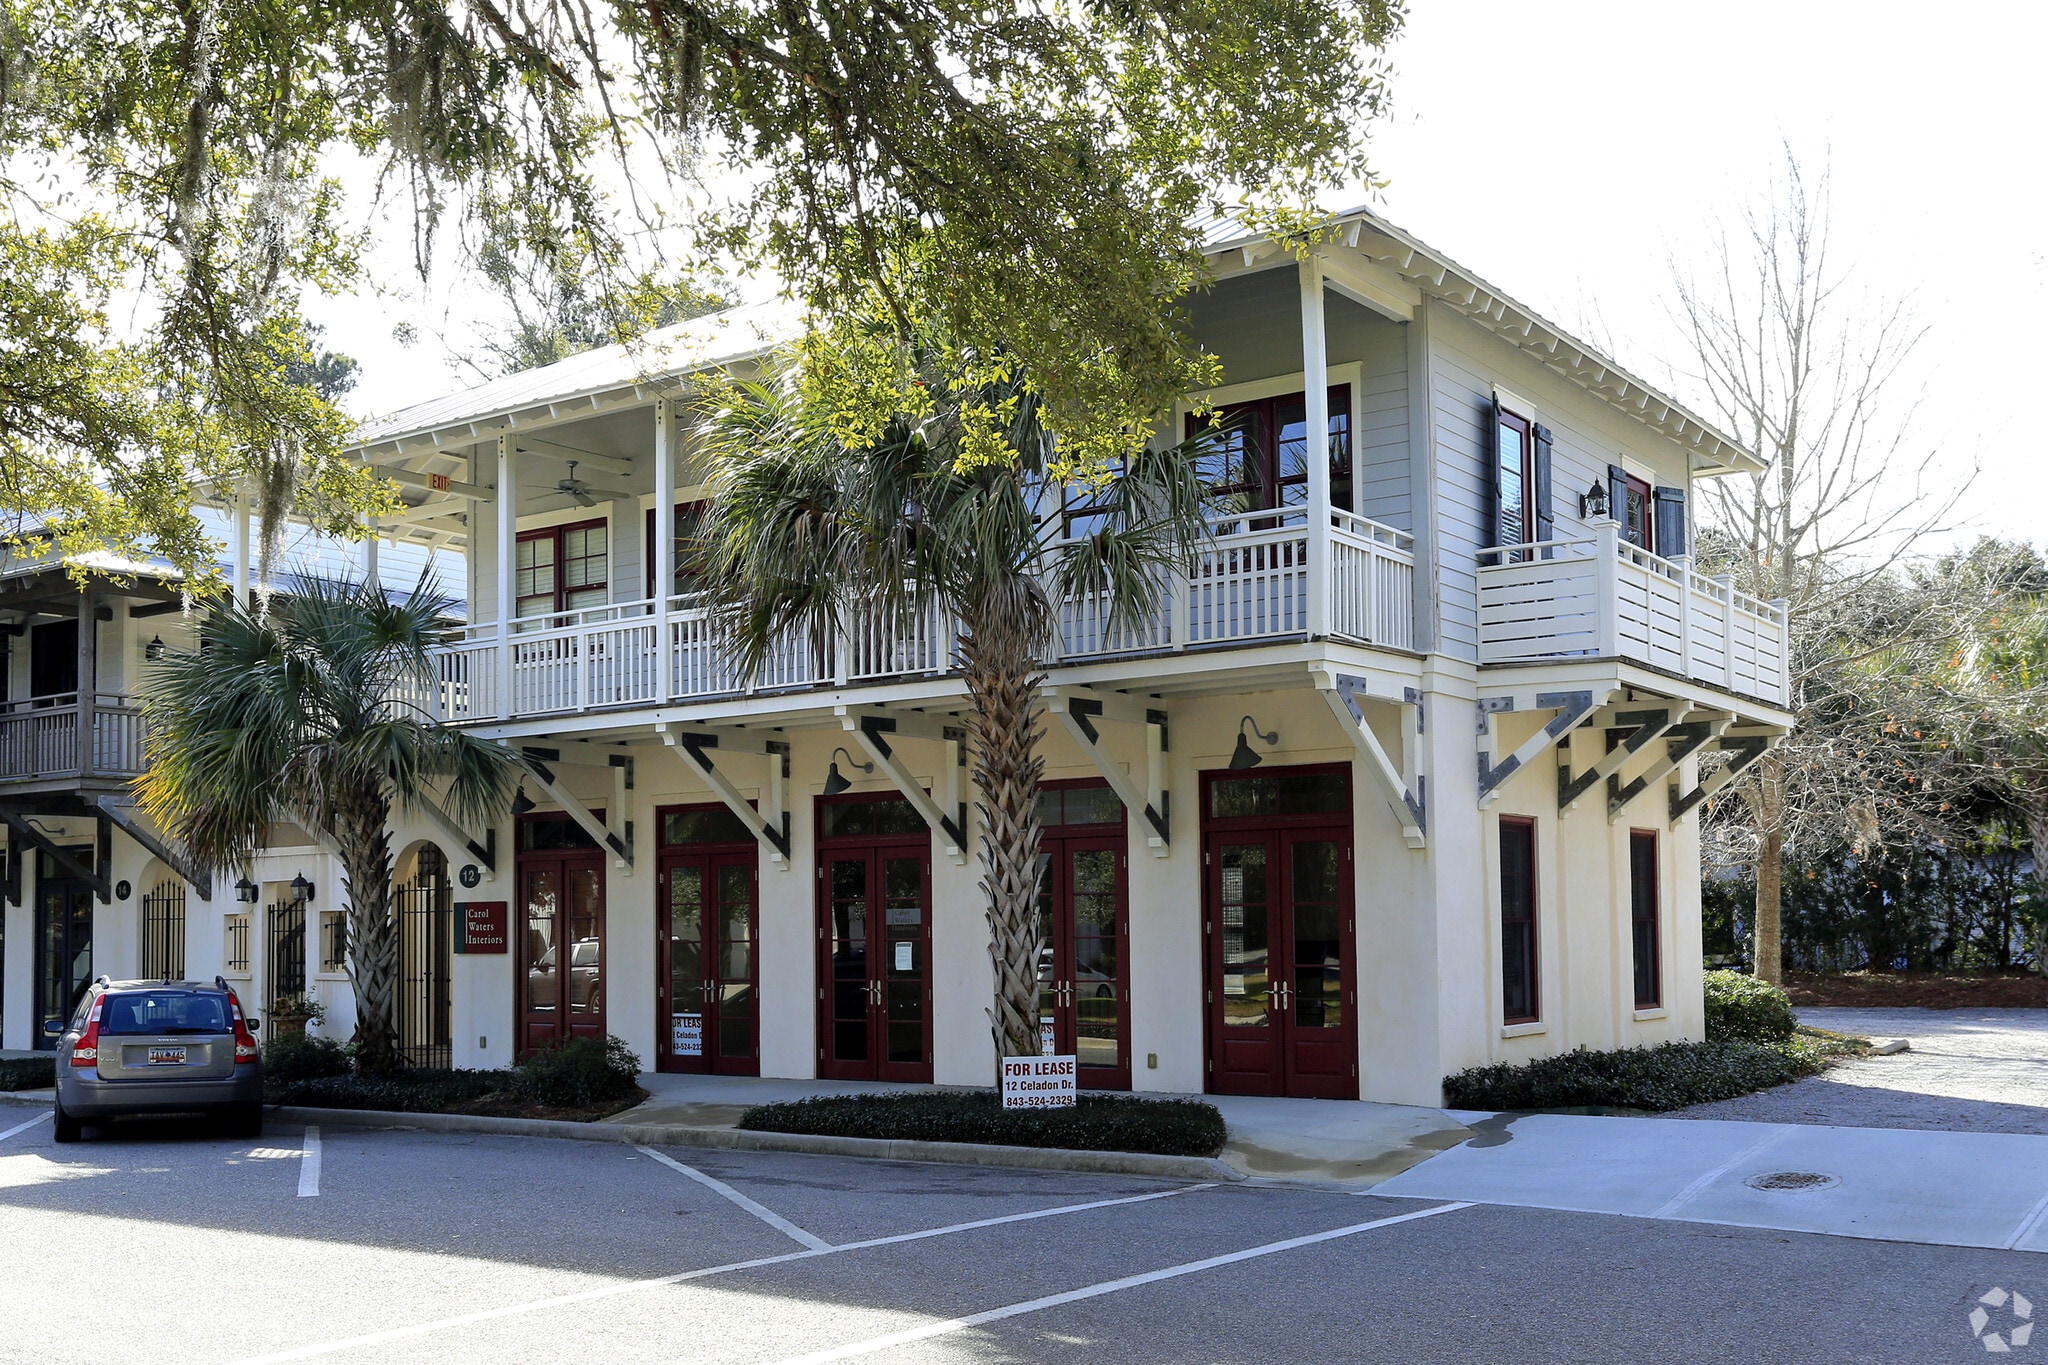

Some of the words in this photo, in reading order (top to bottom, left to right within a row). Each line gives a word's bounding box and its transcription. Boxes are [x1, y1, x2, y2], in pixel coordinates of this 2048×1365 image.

[432, 474, 447, 490] EXIT
[463, 870, 475, 882] 12
[468, 908, 489, 918] Carol
[468, 922, 494, 931] Waters
[468, 935, 503, 944] Interiors
[673, 1018, 682, 1027] OR
[683, 1018, 702, 1028] LEAS
[1005, 1063, 1031, 1076] FOR
[1035, 1062, 1074, 1075] LEASE
[1006, 1081, 1017, 1091] 12
[1020, 1080, 1059, 1091] Celadon
[1061, 1079, 1074, 1089] Dr.
[1006, 1095, 1073, 1106] 843-524-2329
